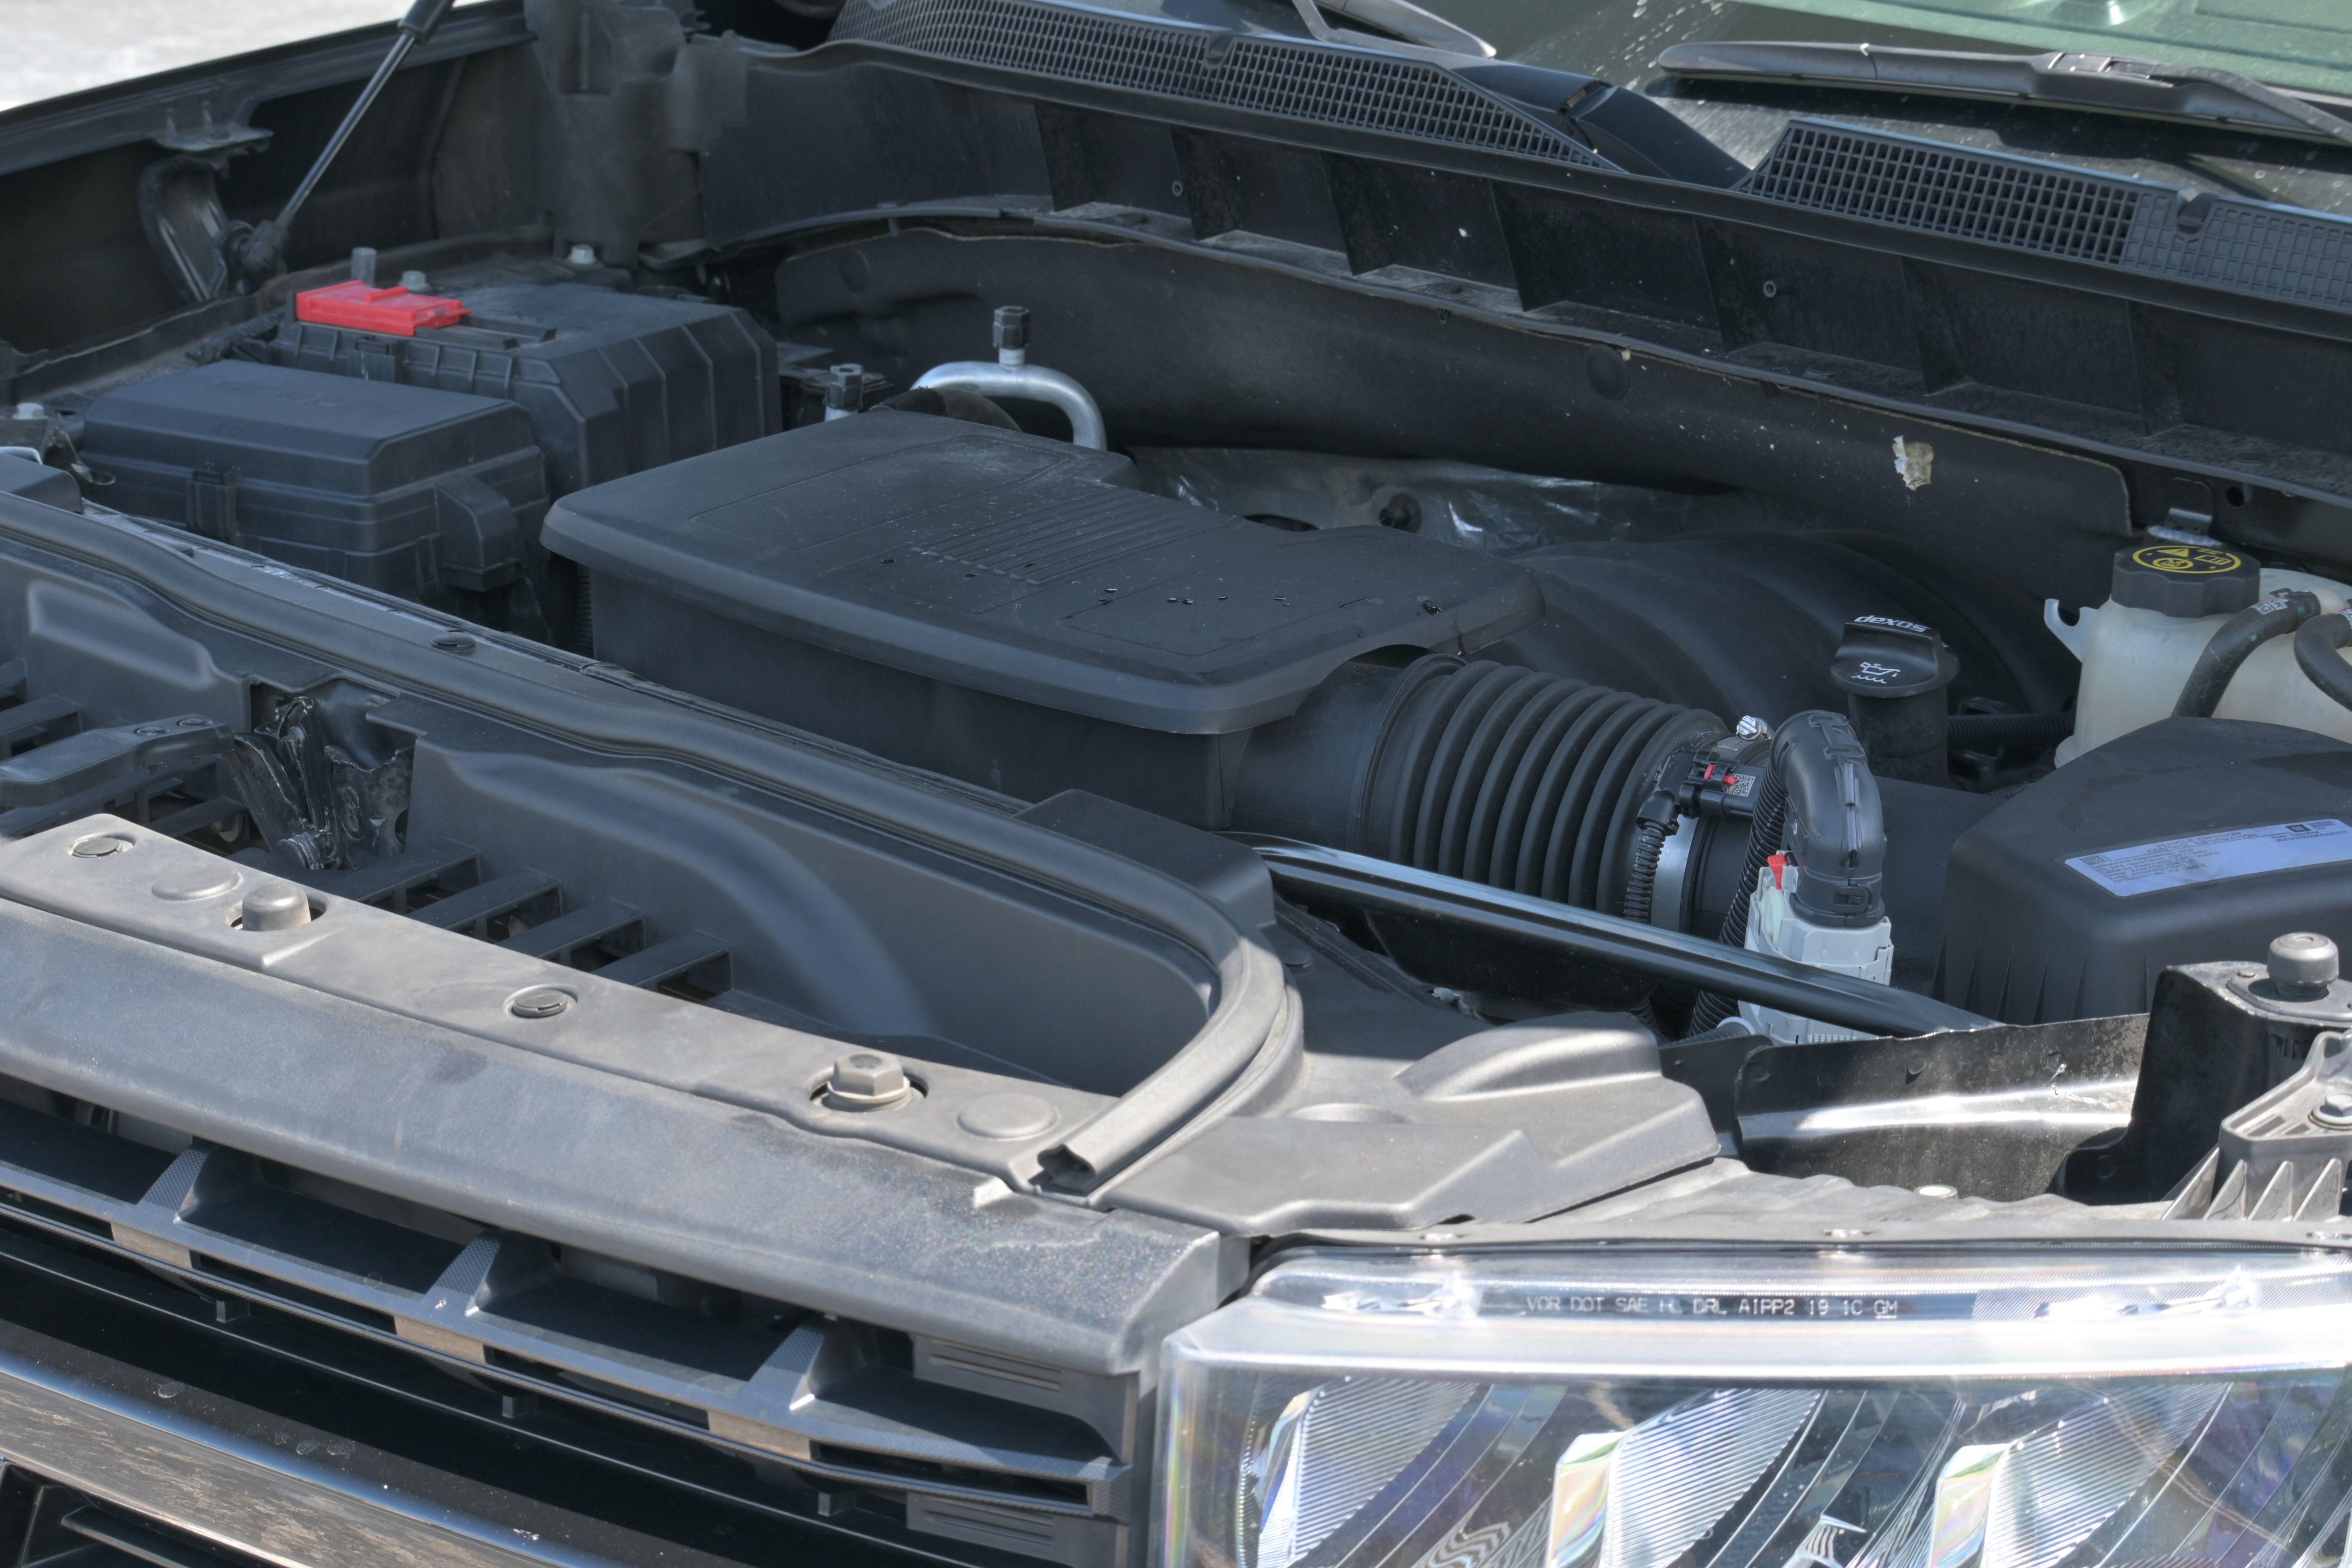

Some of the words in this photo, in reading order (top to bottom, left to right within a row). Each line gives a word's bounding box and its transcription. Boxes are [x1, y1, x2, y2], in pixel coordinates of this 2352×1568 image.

[1854, 615, 1928, 632] dexos
[2147, 844, 2190, 853] CONTROL
[2193, 833, 2258, 845] INFORMATION
[2155, 839, 2193, 847] VEHICLE
[2197, 832, 2241, 840] EMISSION
[1527, 1296, 1561, 1311] VOR
[1571, 1296, 1605, 1312] DOT
[1615, 1297, 1648, 1313] SAE
[1660, 1298, 1683, 1314] HL
[1693, 1298, 1728, 1315] DRL
[1810, 1299, 1829, 1316] 19
[1874, 1299, 1898, 1317] GM
